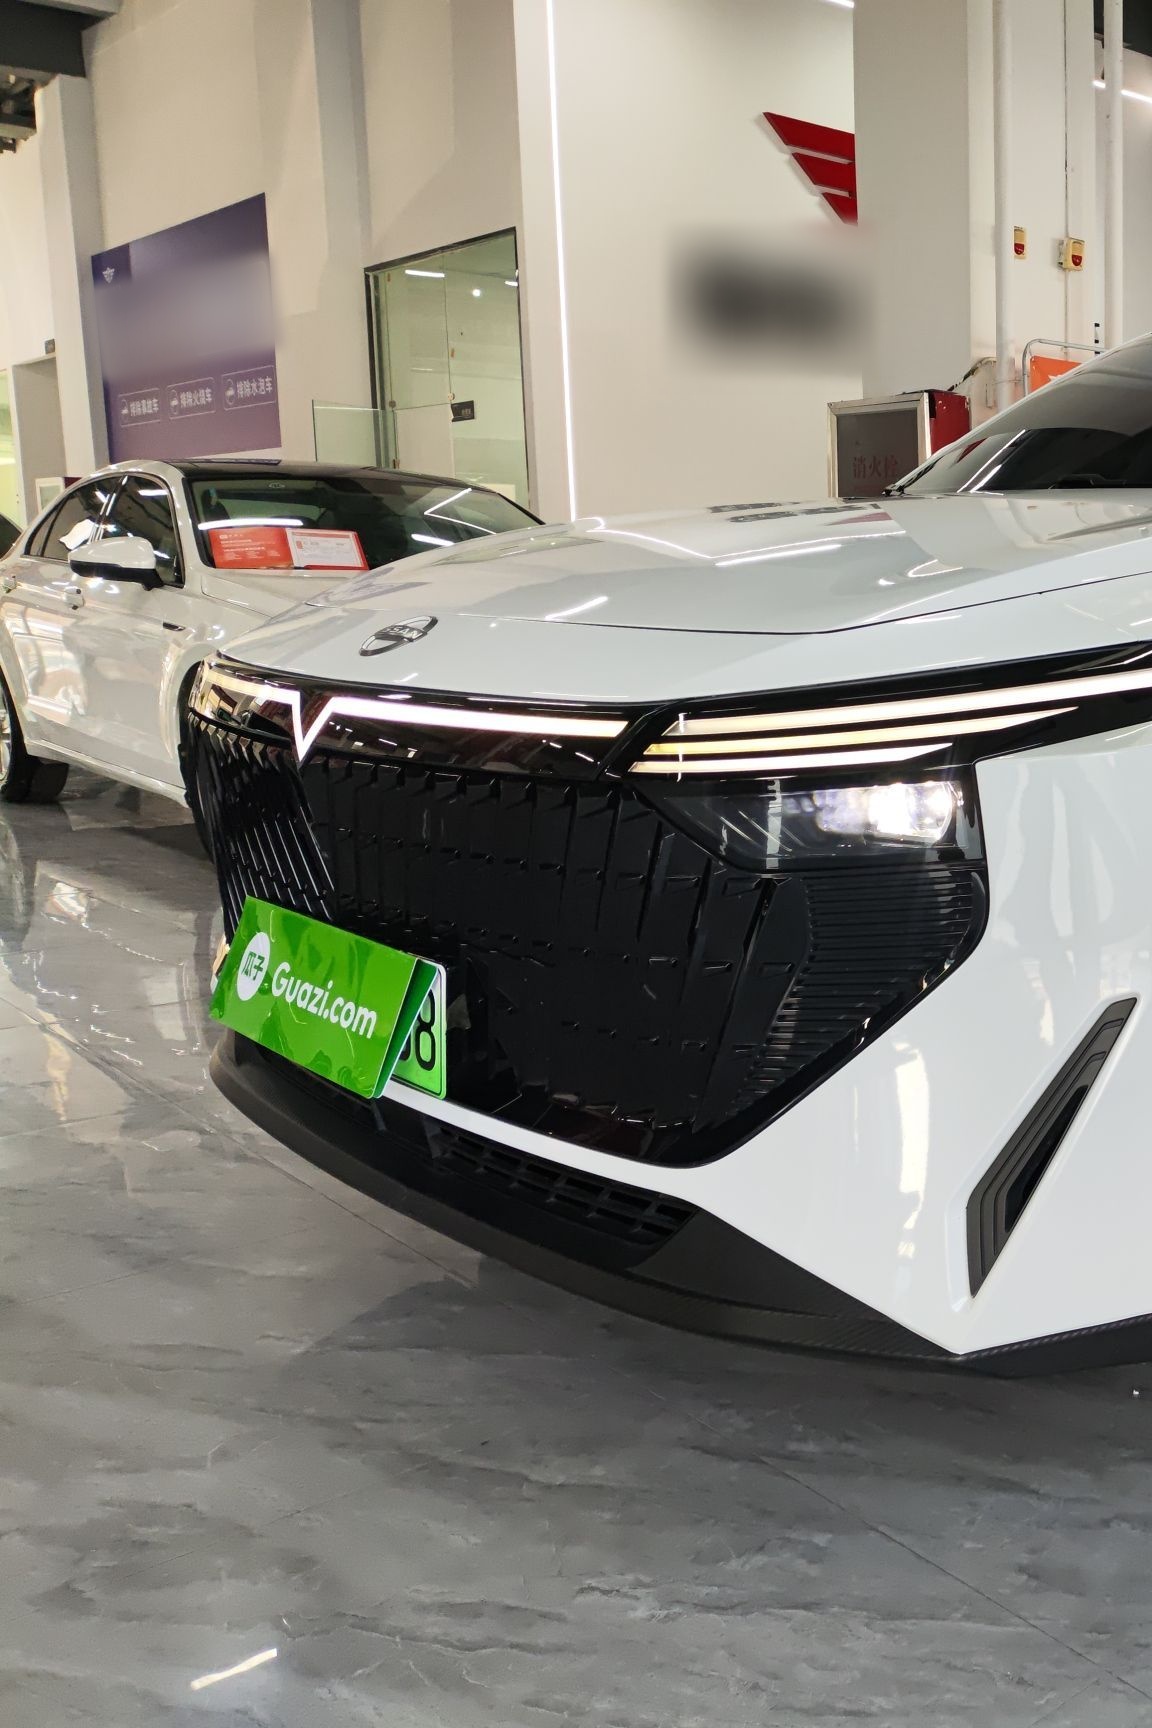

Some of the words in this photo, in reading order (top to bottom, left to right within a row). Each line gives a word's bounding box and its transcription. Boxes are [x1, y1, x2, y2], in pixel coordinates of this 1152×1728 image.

[180, 387, 212, 408] 排除火烧车
[236, 376, 272, 398] 排除水泡车
[271, 961, 377, 1039] Guazi.com
[399, 988, 436, 1071] 8
